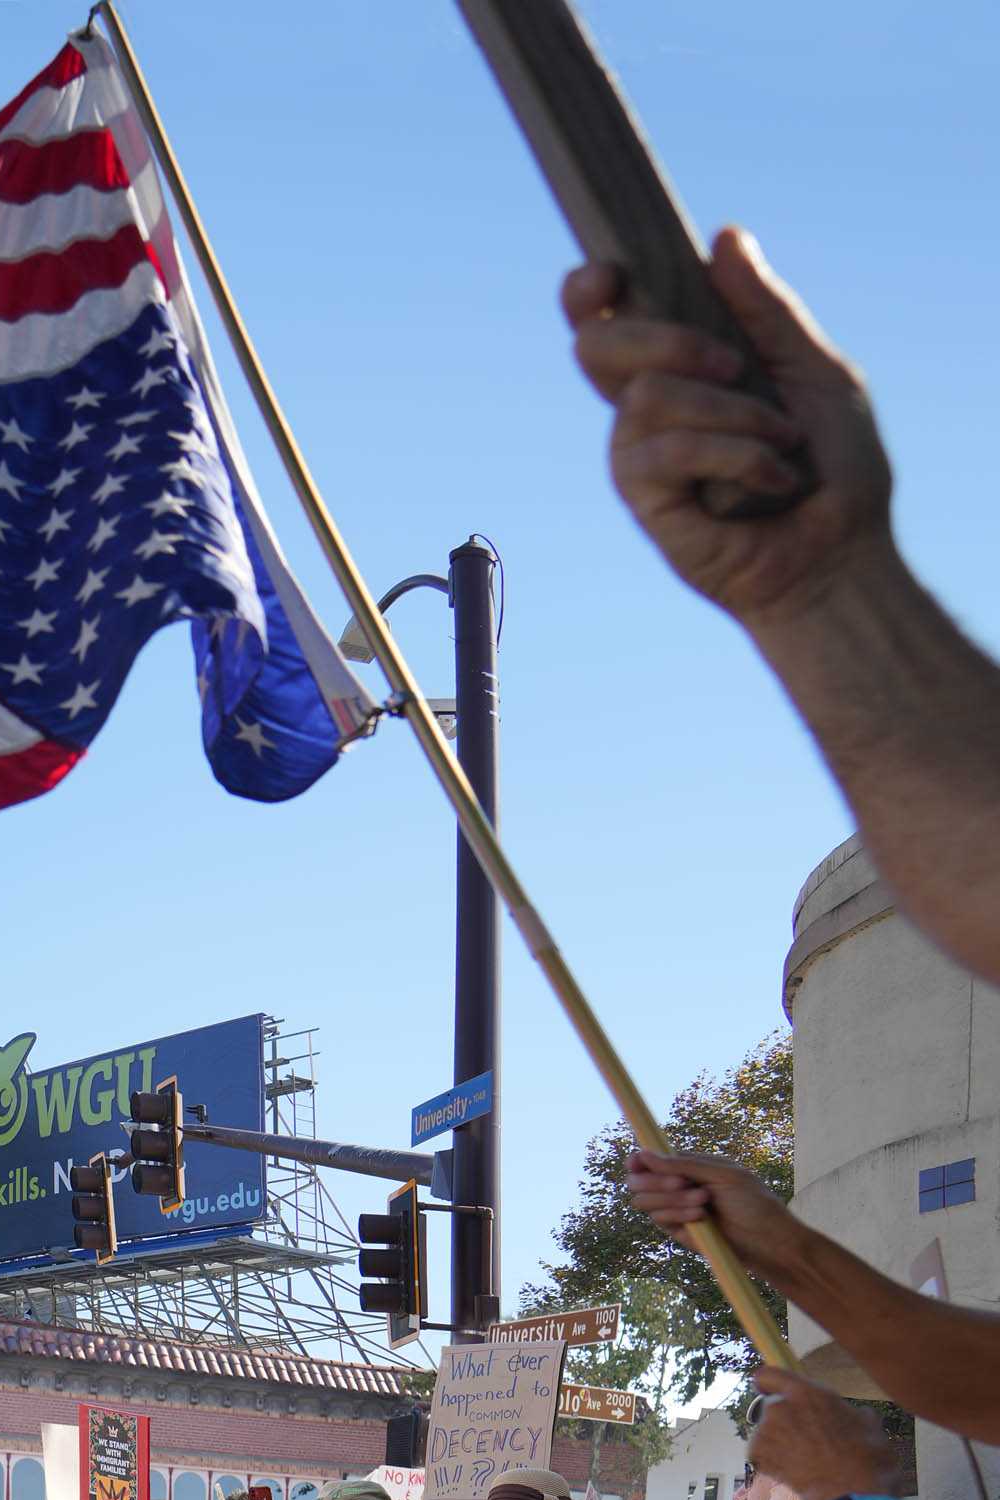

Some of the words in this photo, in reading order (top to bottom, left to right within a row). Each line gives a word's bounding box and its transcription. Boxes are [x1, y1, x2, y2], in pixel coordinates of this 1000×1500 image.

[31, 1047, 157, 1138] WGU
[415, 1096, 468, 1136] University
[491, 1320, 566, 1343] University
[572, 1322, 587, 1337] Ave
[595, 1309, 616, 1325] 1100
[451, 1350, 498, 1381] What
[506, 1353, 549, 1373] ever
[440, 1376, 517, 1416] happened
[532, 1380, 550, 1397] to
[586, 1398, 602, 1411] Ave
[606, 1393, 632, 1408] 2000
[468, 1405, 522, 1422] COMMON
[99, 1438, 108, 1447] WE
[109, 1440, 129, 1451] STAND
[105, 1448, 121, 1458] WITH
[431, 1427, 543, 1464] DECENCY
[97, 1454, 130, 1468] IMMIGRANT
[100, 1464, 126, 1476] FAMILIES
[384, 1468, 404, 1485] NO
